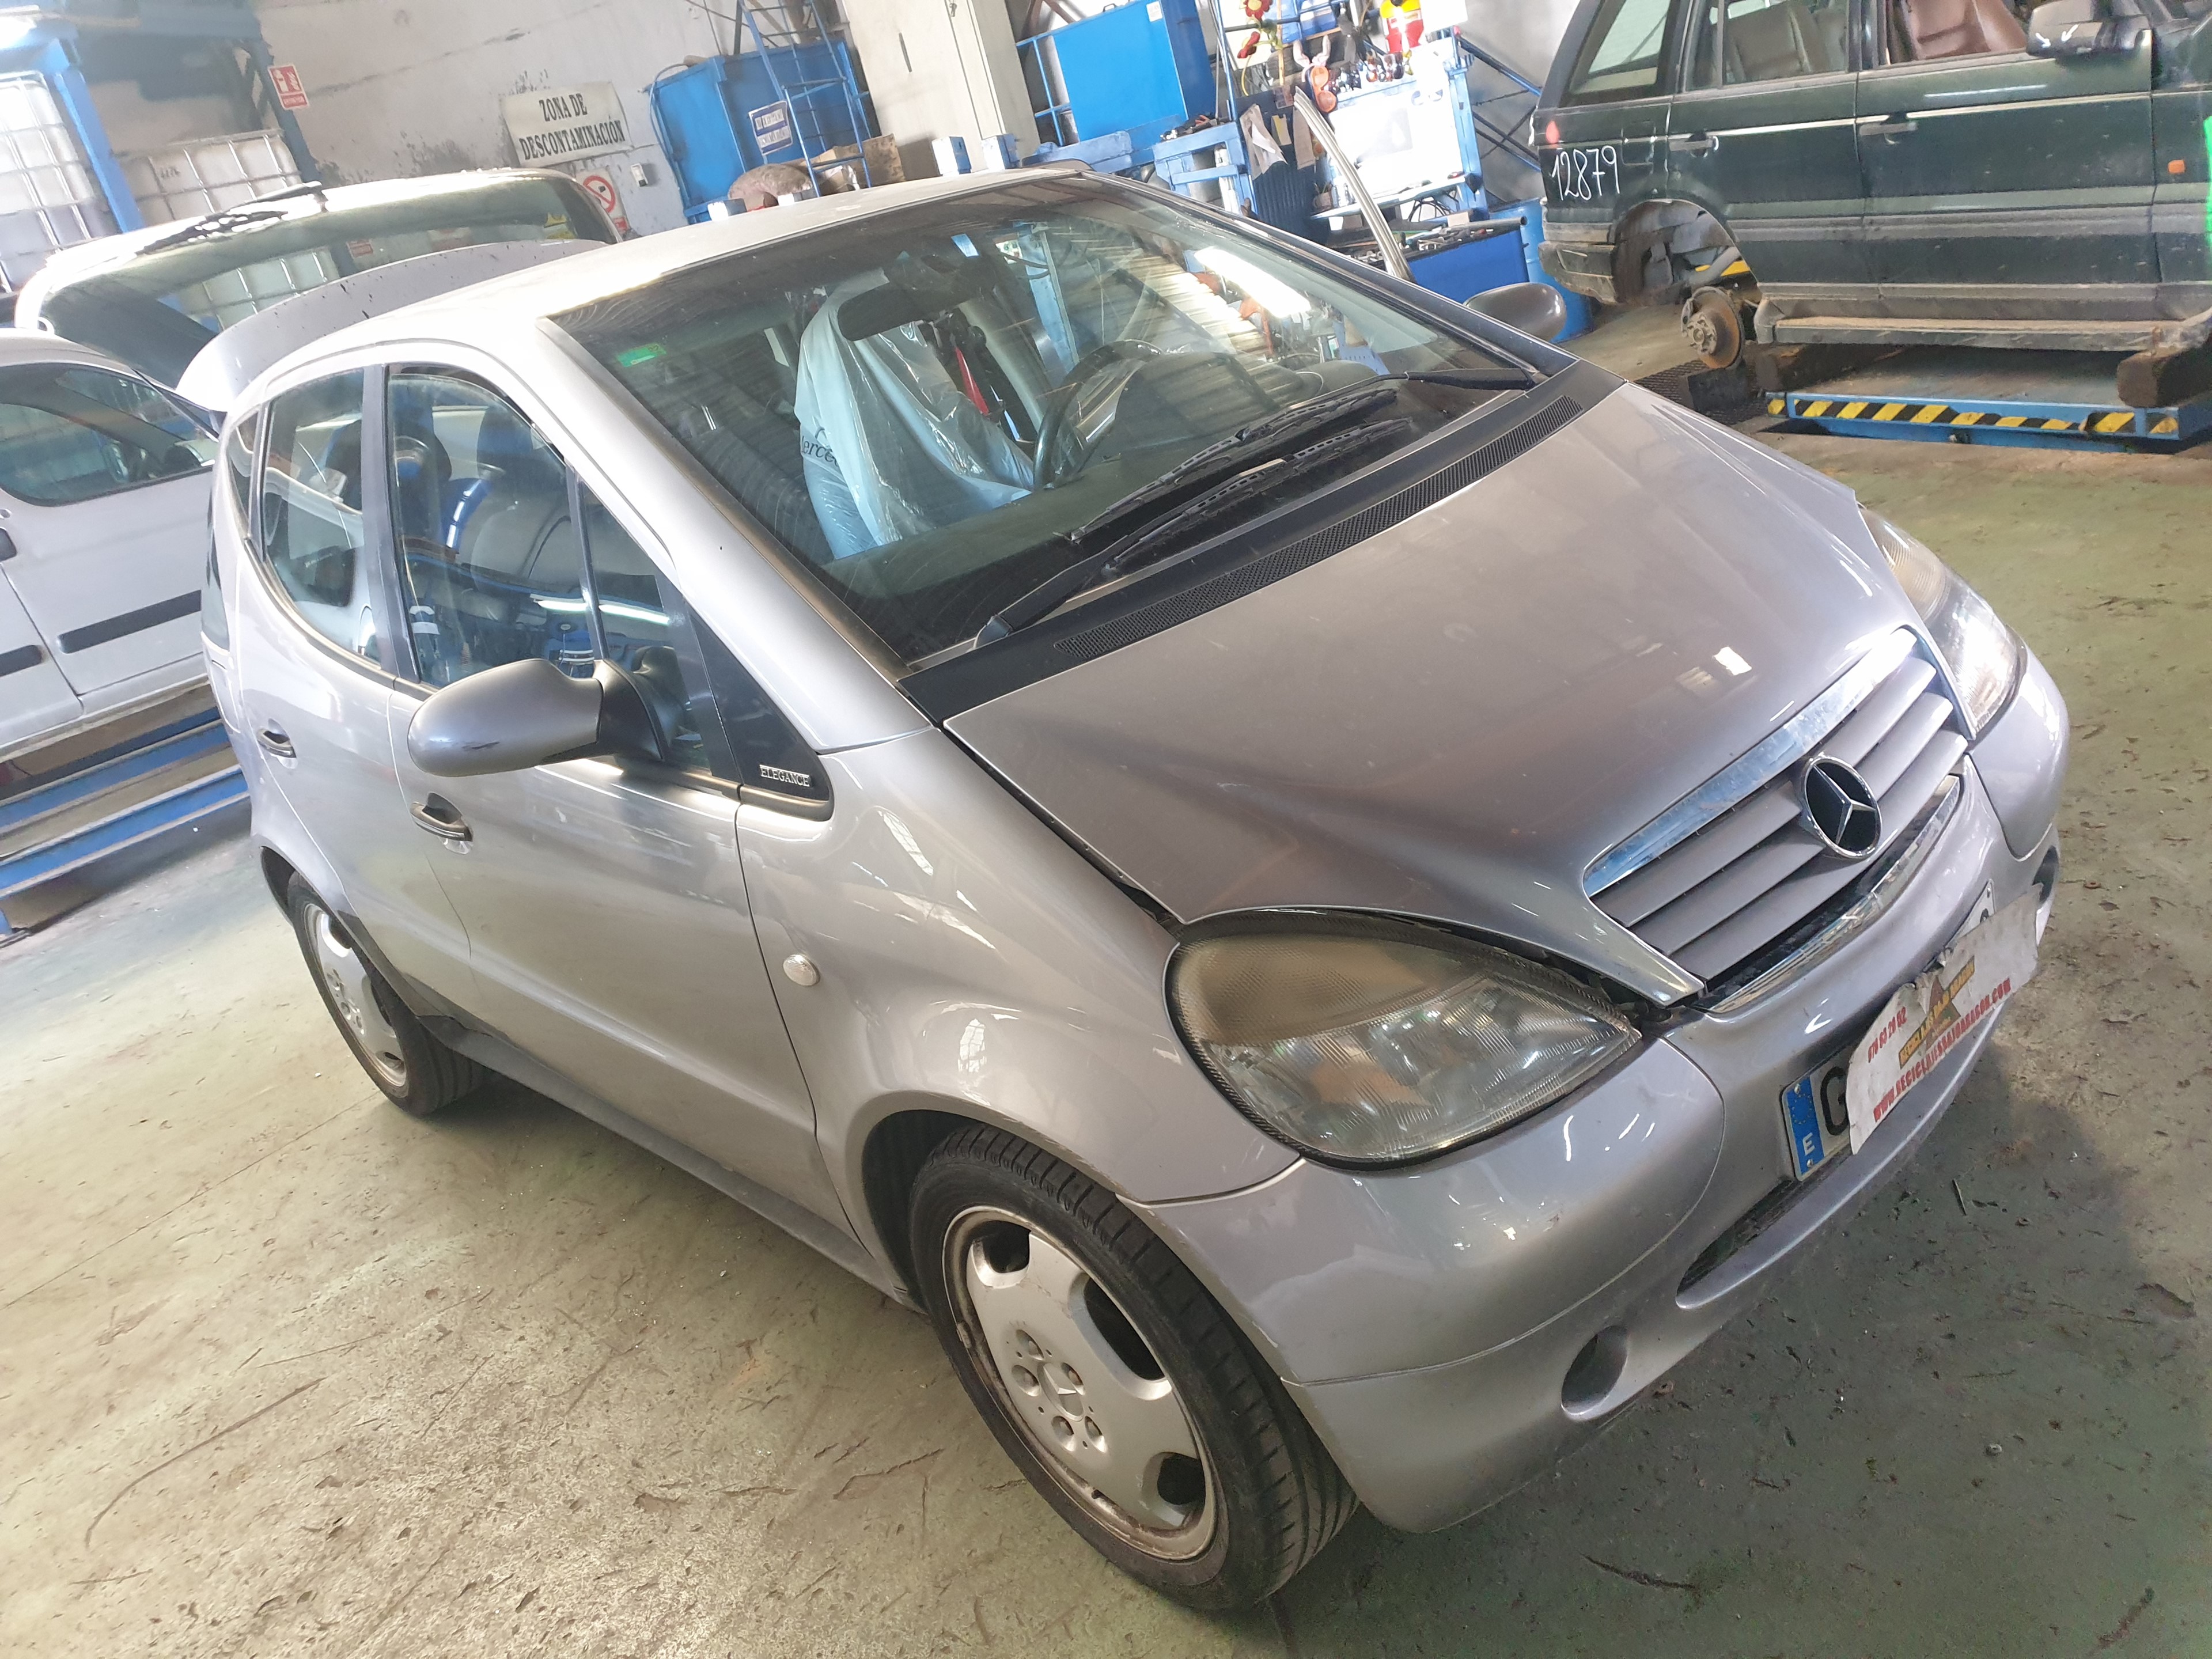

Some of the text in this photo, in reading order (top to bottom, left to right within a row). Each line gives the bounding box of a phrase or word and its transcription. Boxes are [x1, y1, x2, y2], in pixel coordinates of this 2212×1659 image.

[539, 93, 588, 122] ZONA DE
[518, 115, 626, 160] DESCONTAMINACIÓN
[1551, 145, 1620, 200] 12879
[760, 766, 810, 787] ELEGANCE
[1802, 1132, 1815, 1156] E
